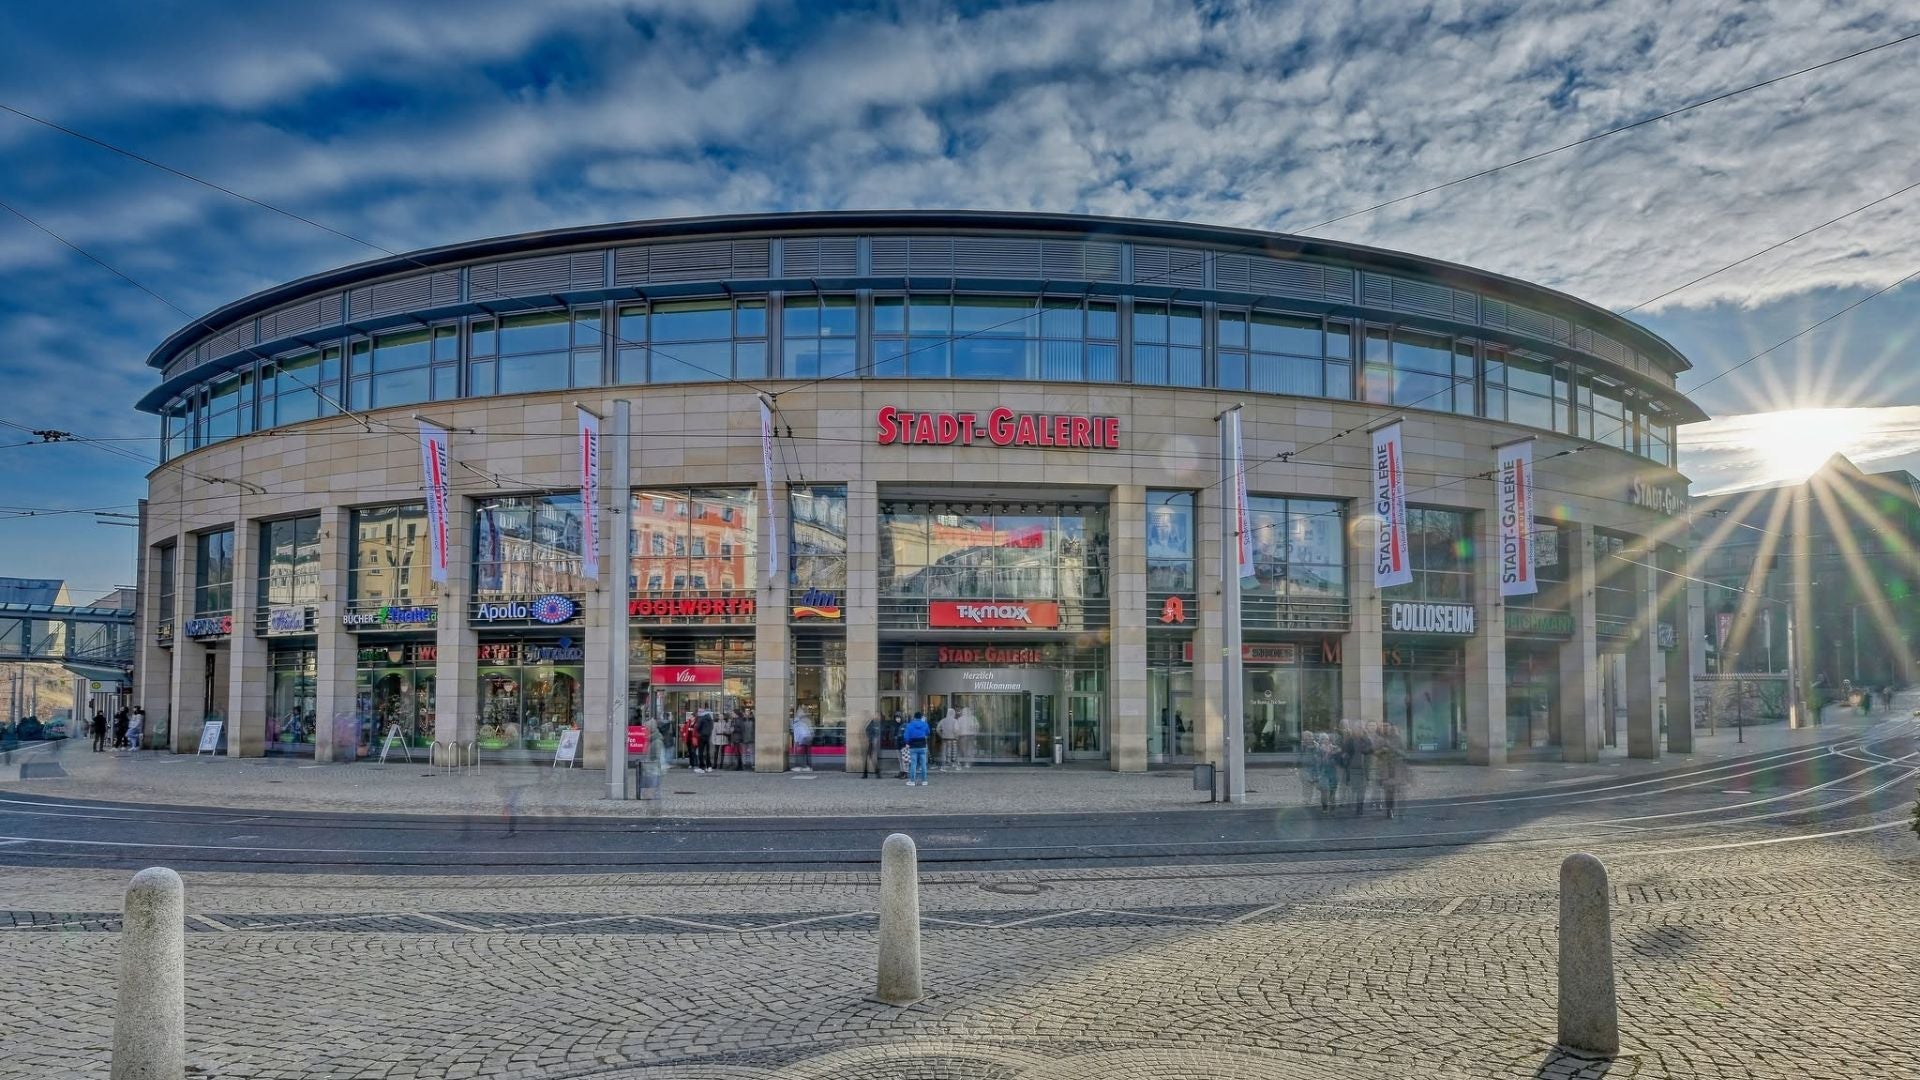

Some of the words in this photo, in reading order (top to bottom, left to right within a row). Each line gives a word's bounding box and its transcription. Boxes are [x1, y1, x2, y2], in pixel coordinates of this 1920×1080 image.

[877, 406, 1120, 448] STADT-GALERIE
[1378, 443, 1391, 575] STADT-GALERIE
[1503, 460, 1517, 583] STADT-GALERIE
[801, 587, 836, 607] dm
[477, 603, 527, 622] Apollo
[1391, 603, 1474, 633] COLLOSEUM
[676, 668, 696, 682] Viba
[962, 672, 994, 680] Herzlich
[974, 682, 1021, 690] Willkommen
